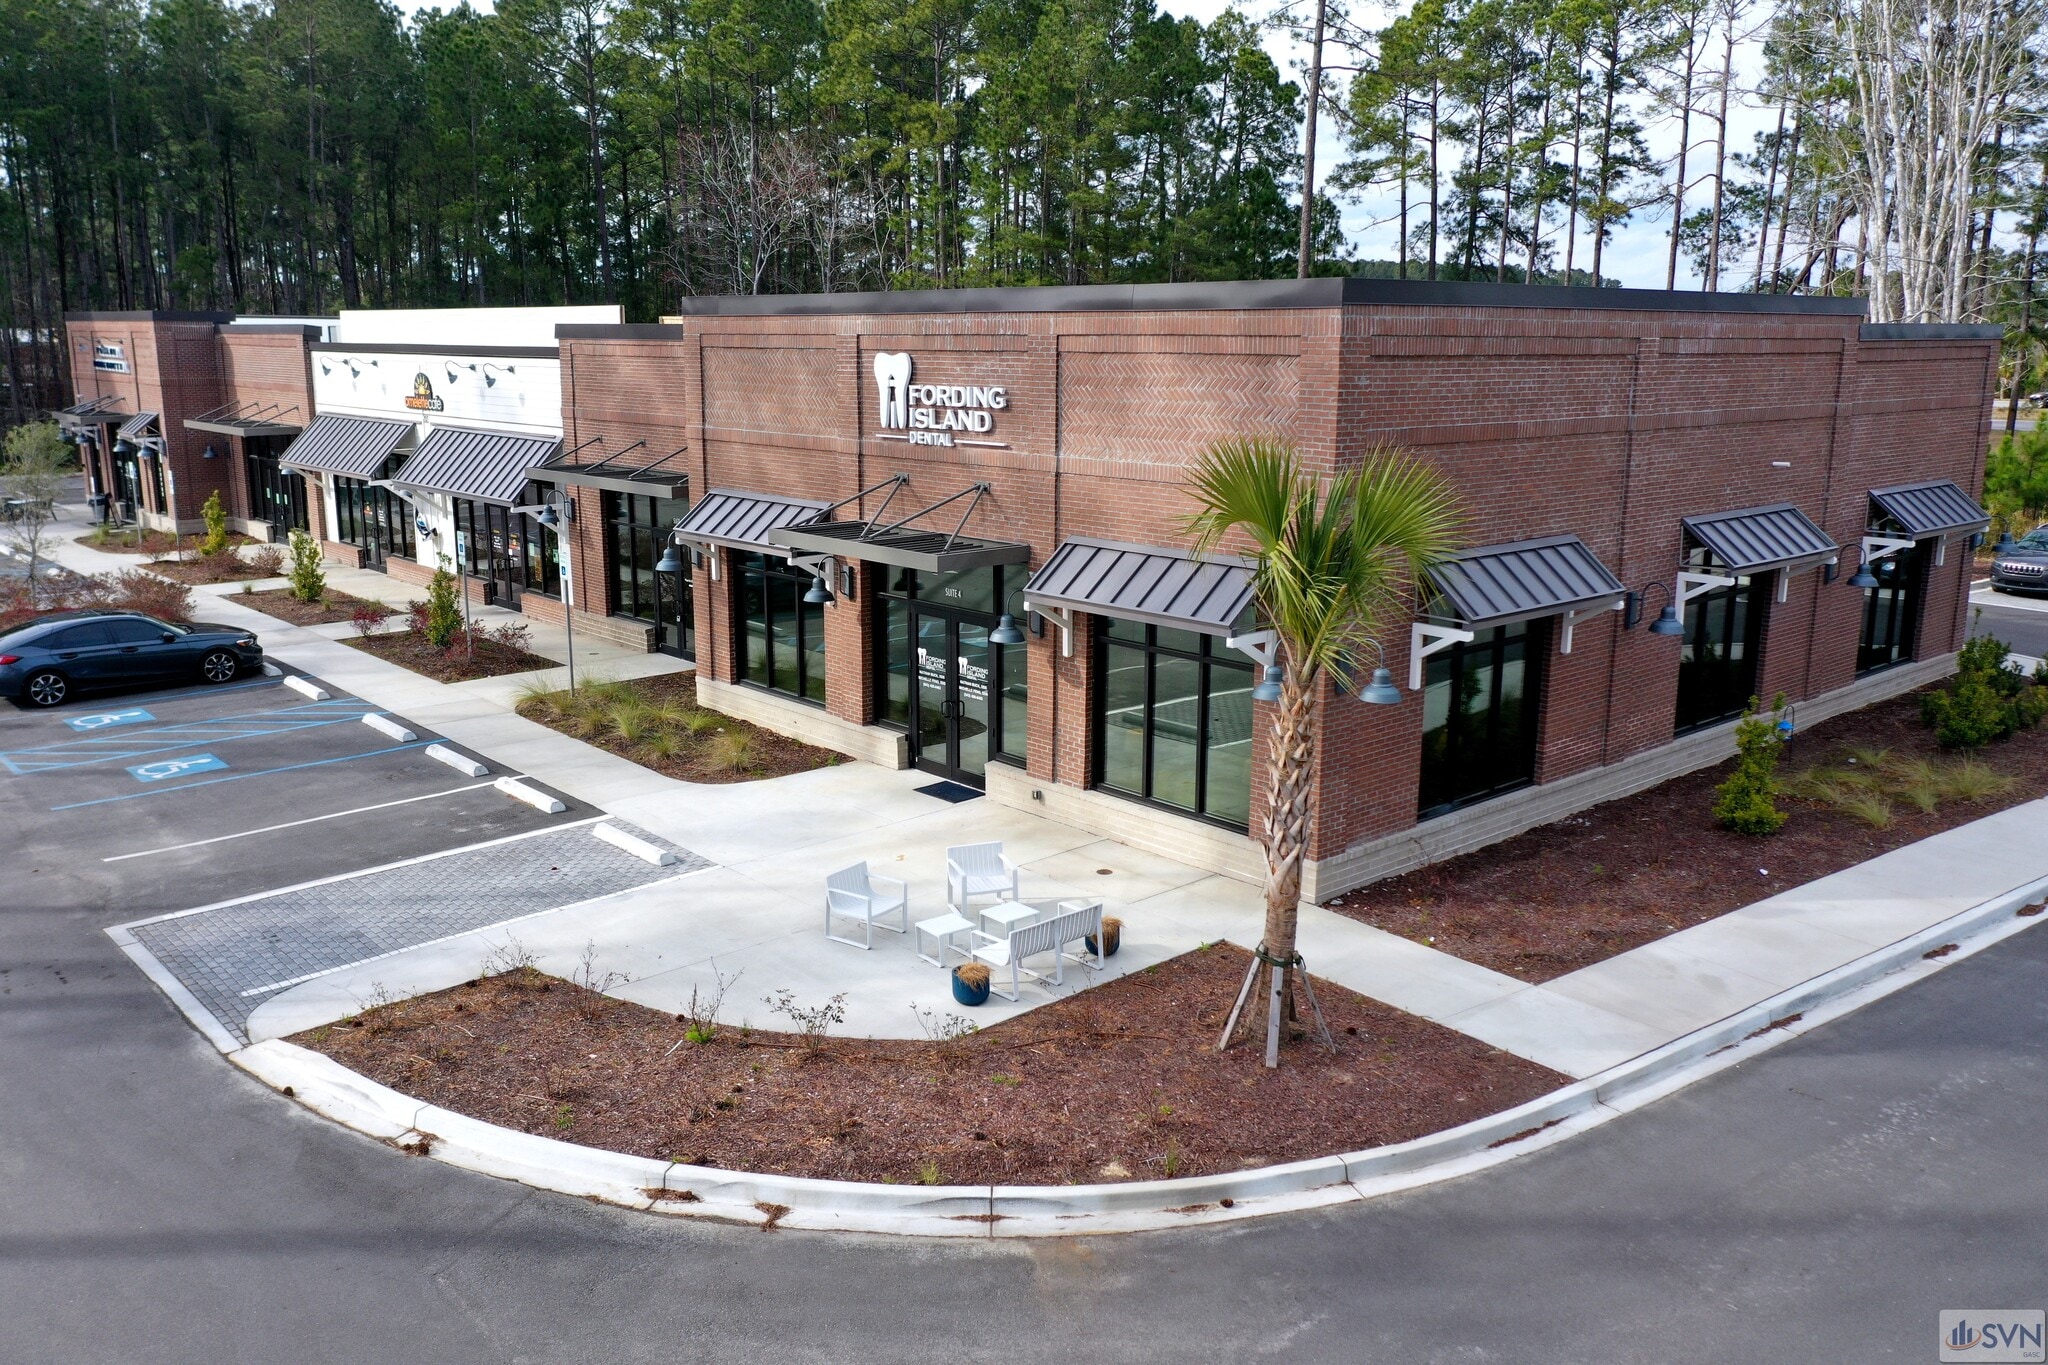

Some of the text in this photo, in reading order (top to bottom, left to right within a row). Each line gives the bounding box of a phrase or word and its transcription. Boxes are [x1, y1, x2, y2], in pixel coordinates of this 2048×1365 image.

[908, 384, 1007, 409] FORDING
[909, 408, 993, 432] ISLAND
[909, 431, 955, 447] DENTAL
